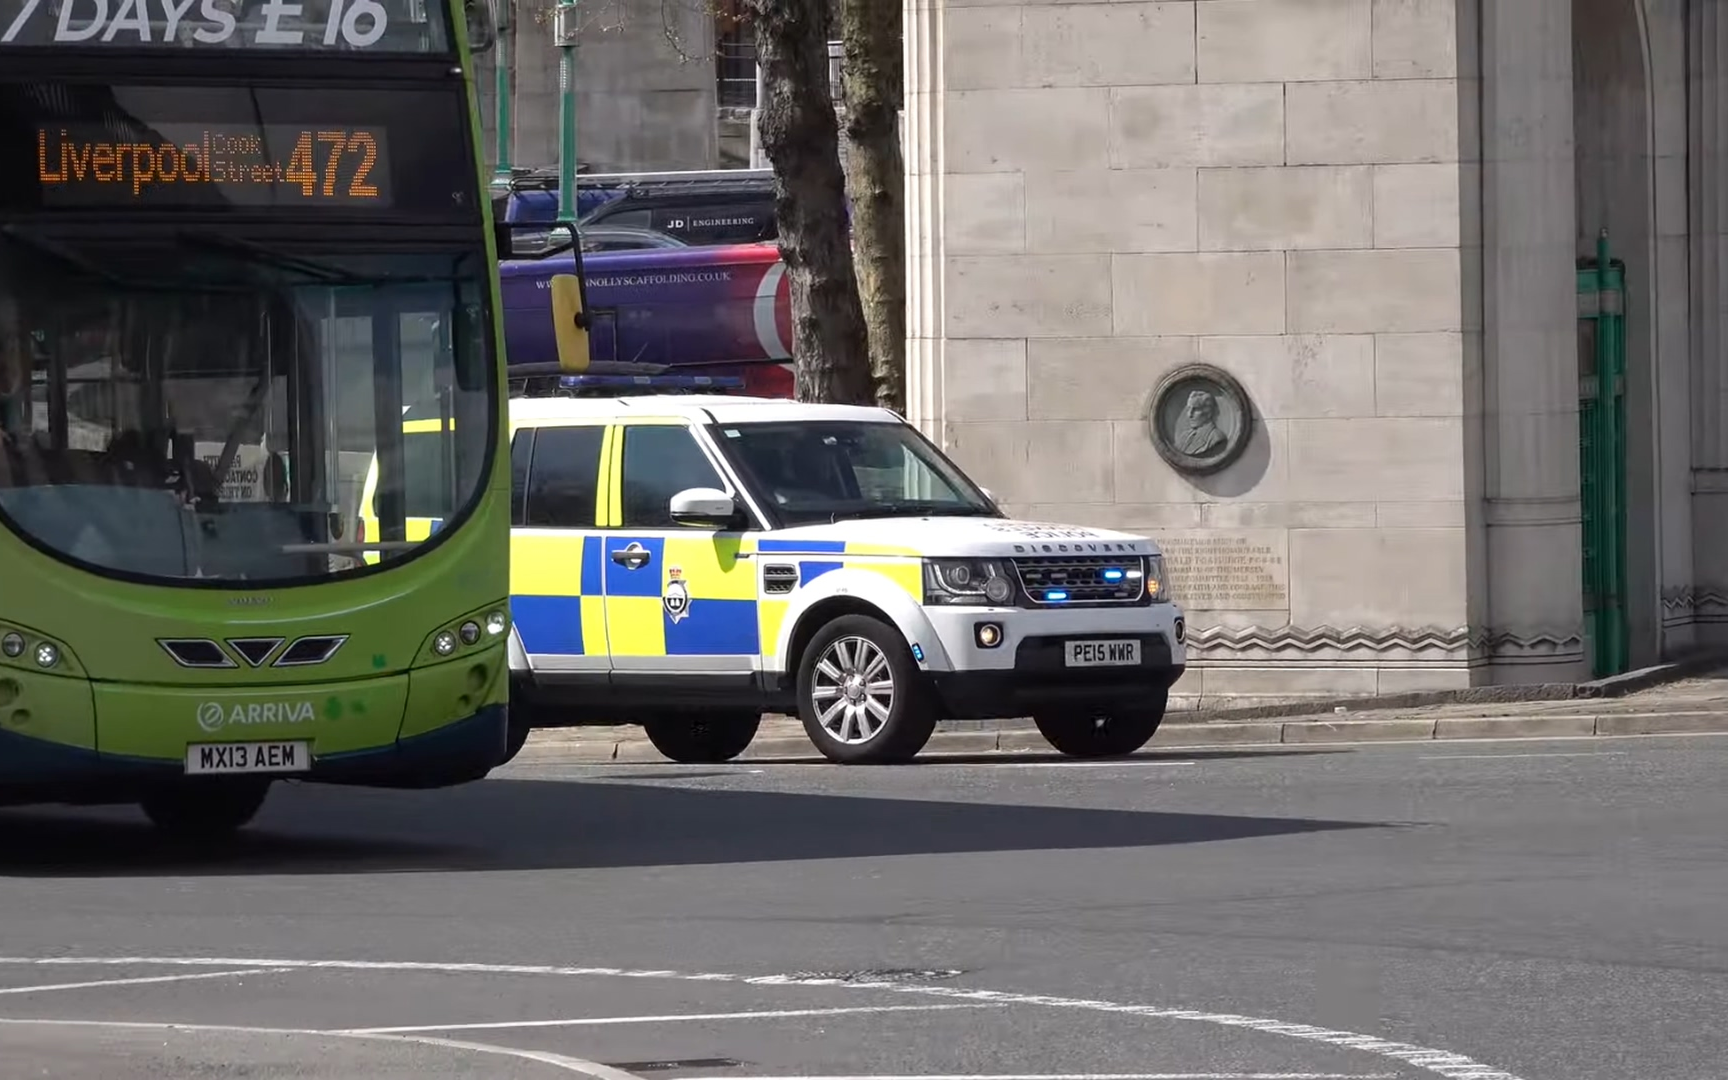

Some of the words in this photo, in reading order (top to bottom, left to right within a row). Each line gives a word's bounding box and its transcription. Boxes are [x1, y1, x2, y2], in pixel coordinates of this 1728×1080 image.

[54, 0, 236, 44] DAYS
[213, 134, 261, 154] Cook
[39, 129, 210, 195] Liverpool
[213, 161, 285, 182] Street
[286, 131, 378, 196] 472
[667, 219, 684, 229] JD
[692, 217, 754, 227] ENGINEERING
[1013, 543, 1137, 554] DISCOVERY
[1074, 643, 1106, 662] PE15
[1107, 642, 1134, 661] WWR
[229, 701, 315, 723] ARRIVA
[201, 746, 248, 769] MX13
[254, 744, 295, 767] AEM
